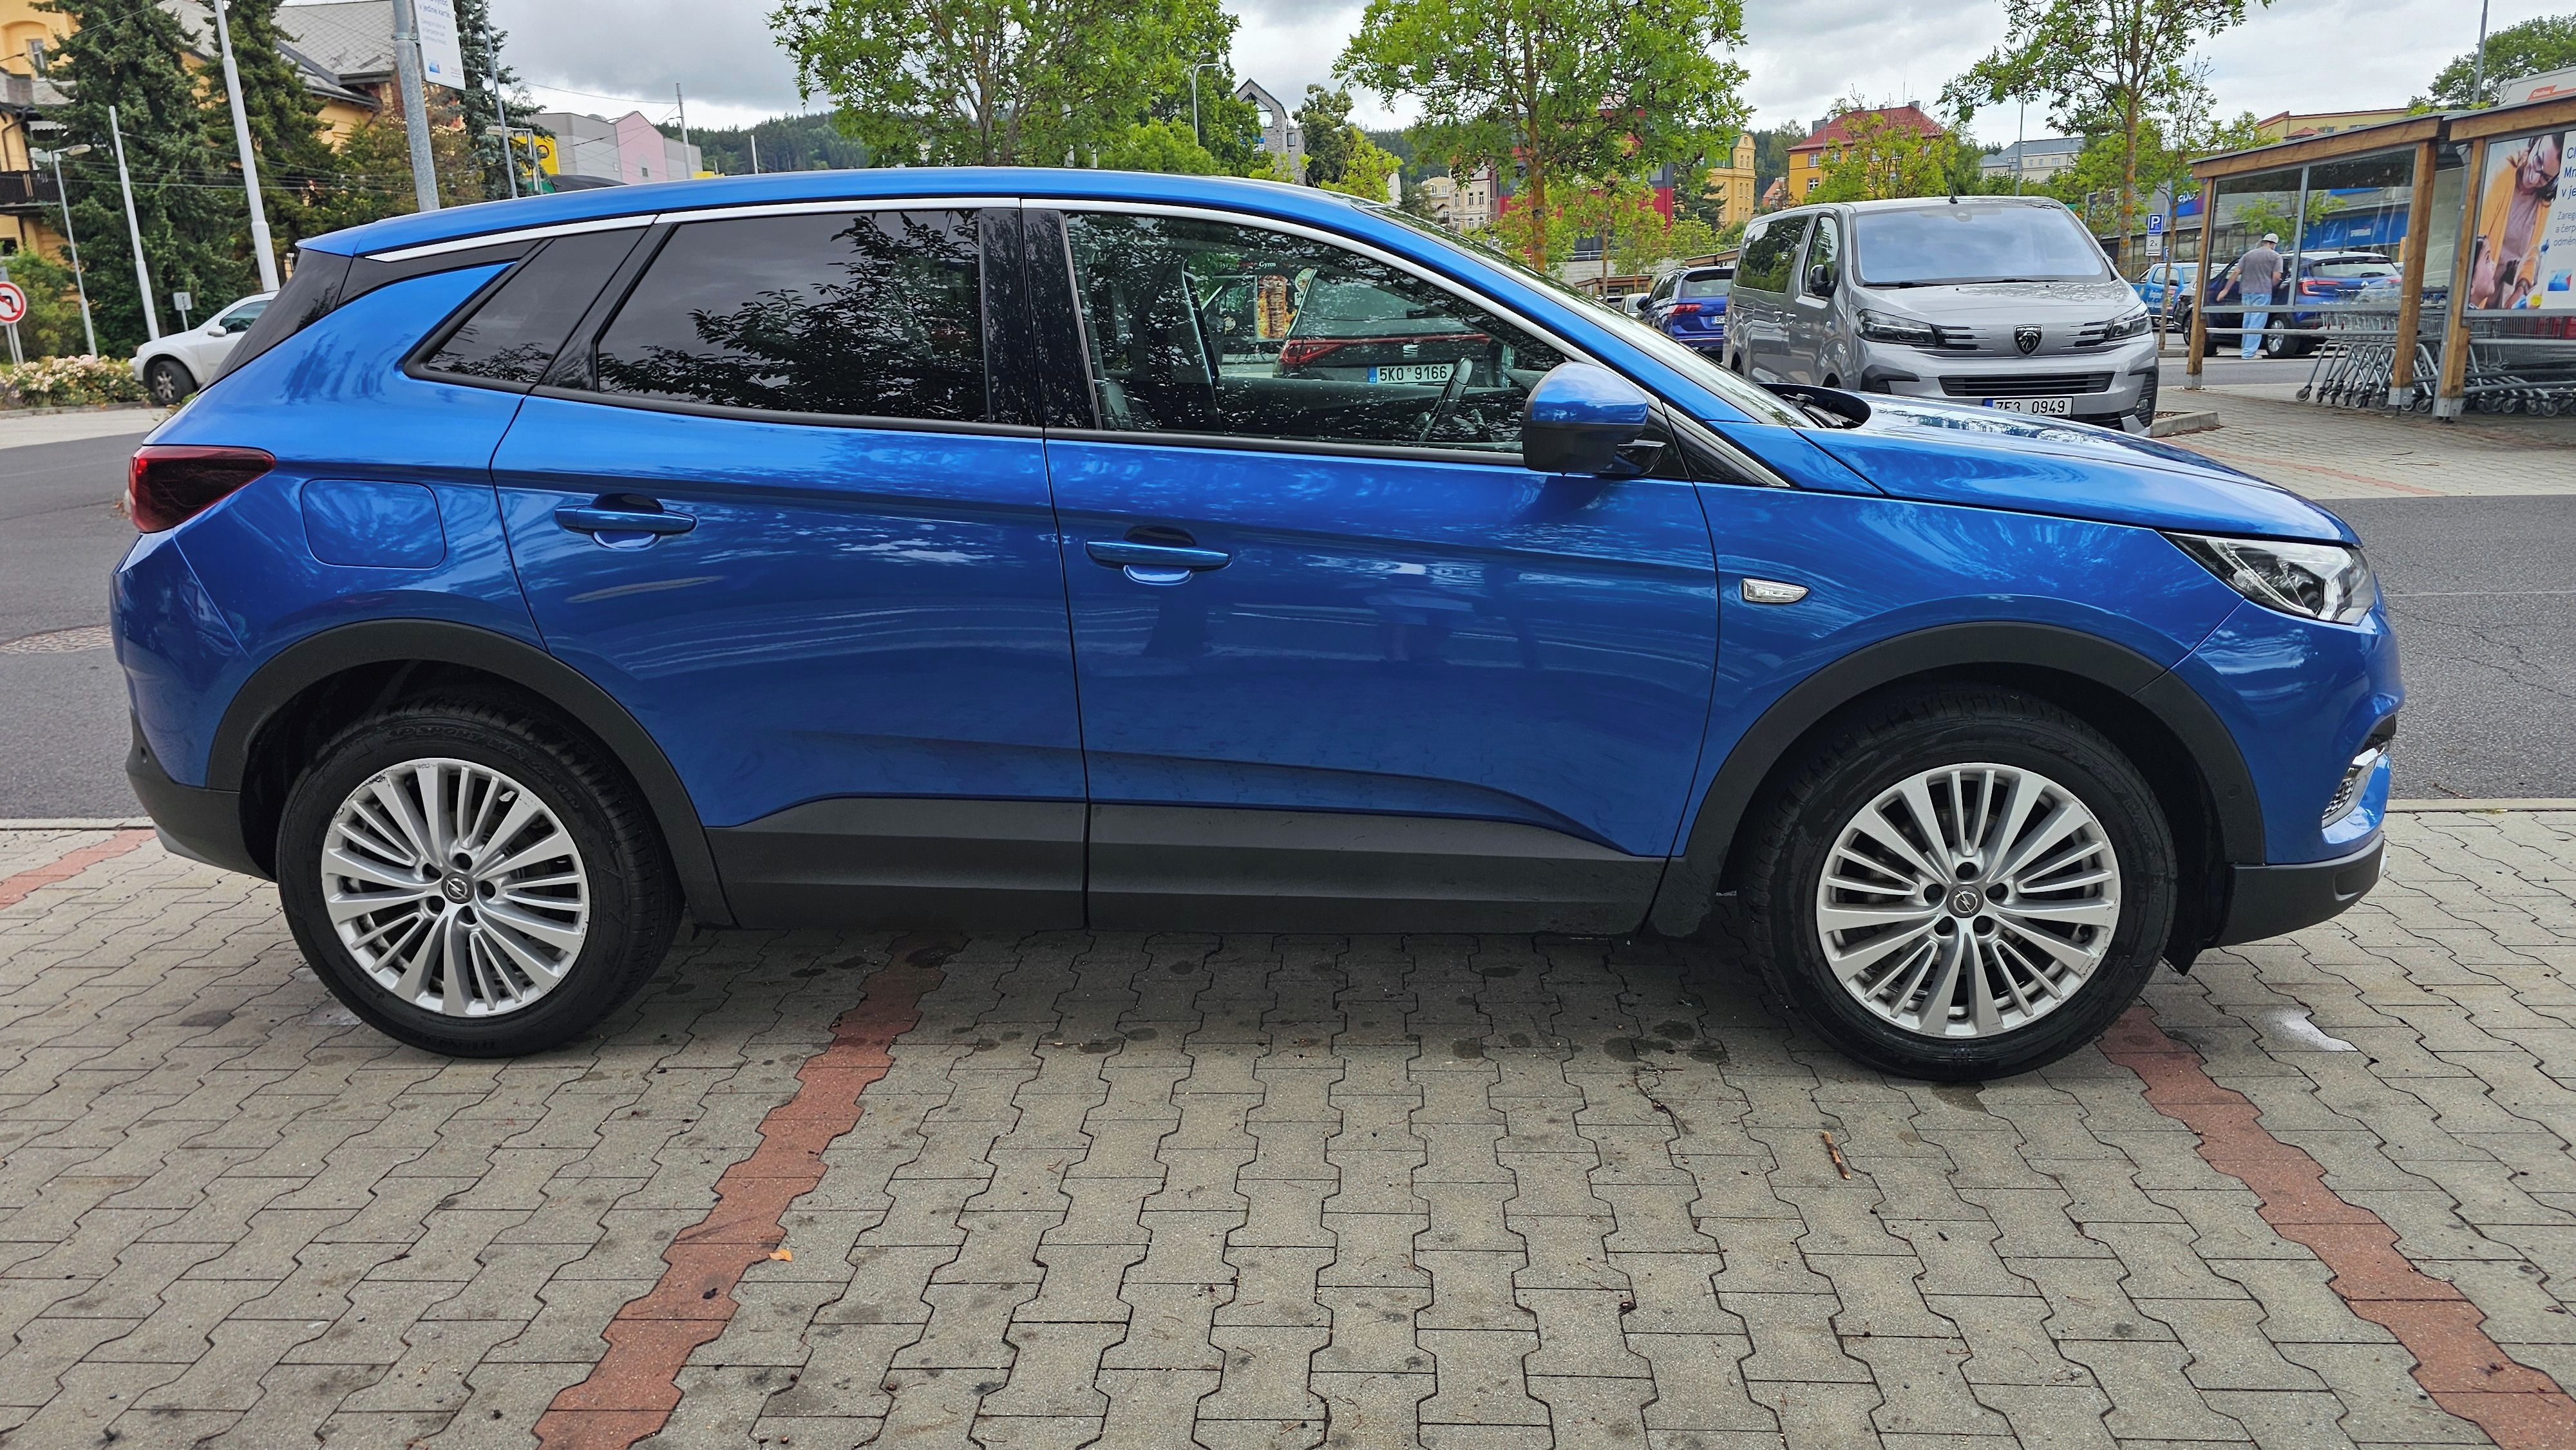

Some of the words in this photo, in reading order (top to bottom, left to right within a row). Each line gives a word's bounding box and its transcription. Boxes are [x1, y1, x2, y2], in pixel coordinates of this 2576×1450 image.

[2562, 188, 2567, 198] v
[2150, 216, 2161, 229] P
[1415, 366, 1447, 380] 9166
[2031, 400, 2065, 414] 0949
